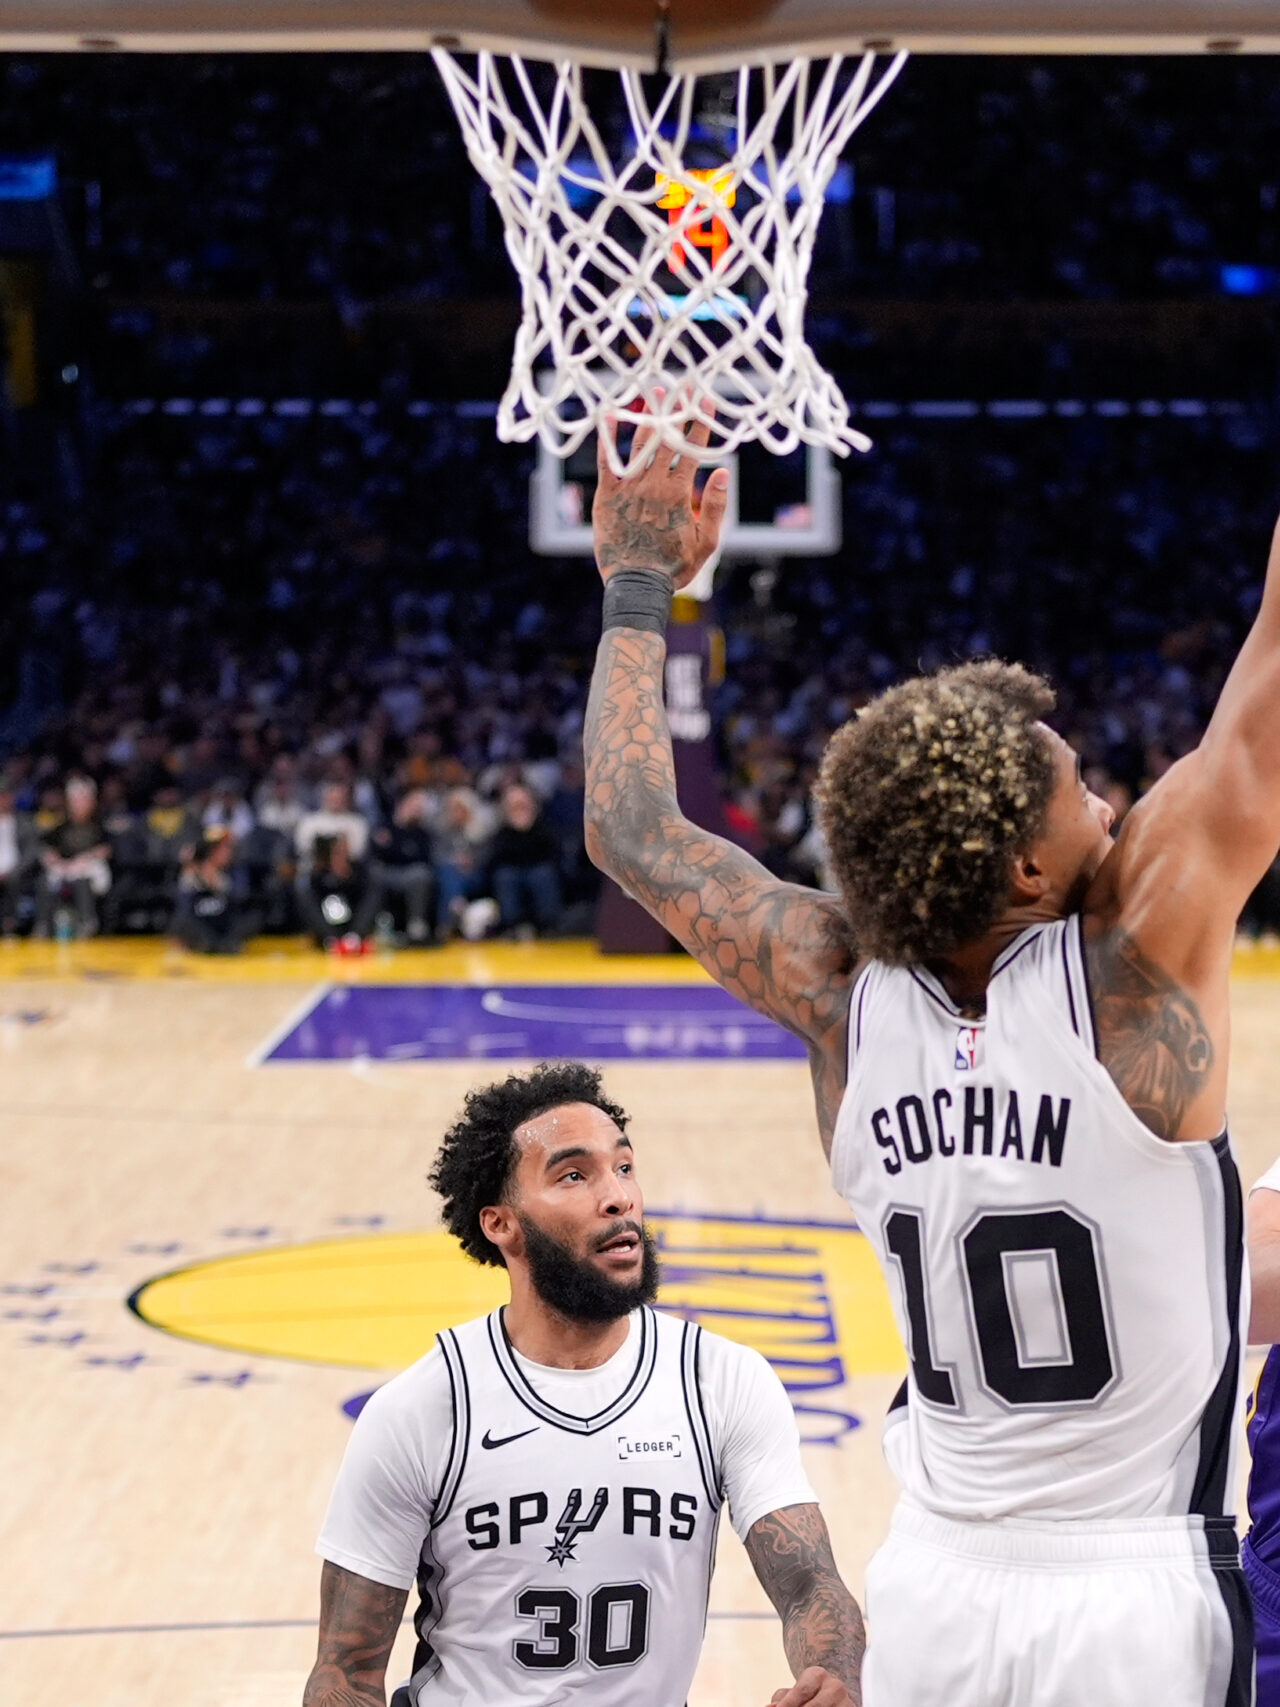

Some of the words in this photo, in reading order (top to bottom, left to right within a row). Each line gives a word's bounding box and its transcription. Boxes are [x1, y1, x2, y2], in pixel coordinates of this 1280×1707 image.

[871, 1086, 1072, 1176] SOCHAN
[880, 1200, 1123, 1416] 10
[626, 1441, 673, 1453] LEDGER
[465, 1487, 698, 1569] SPURS
[512, 1579, 652, 1671] 30
